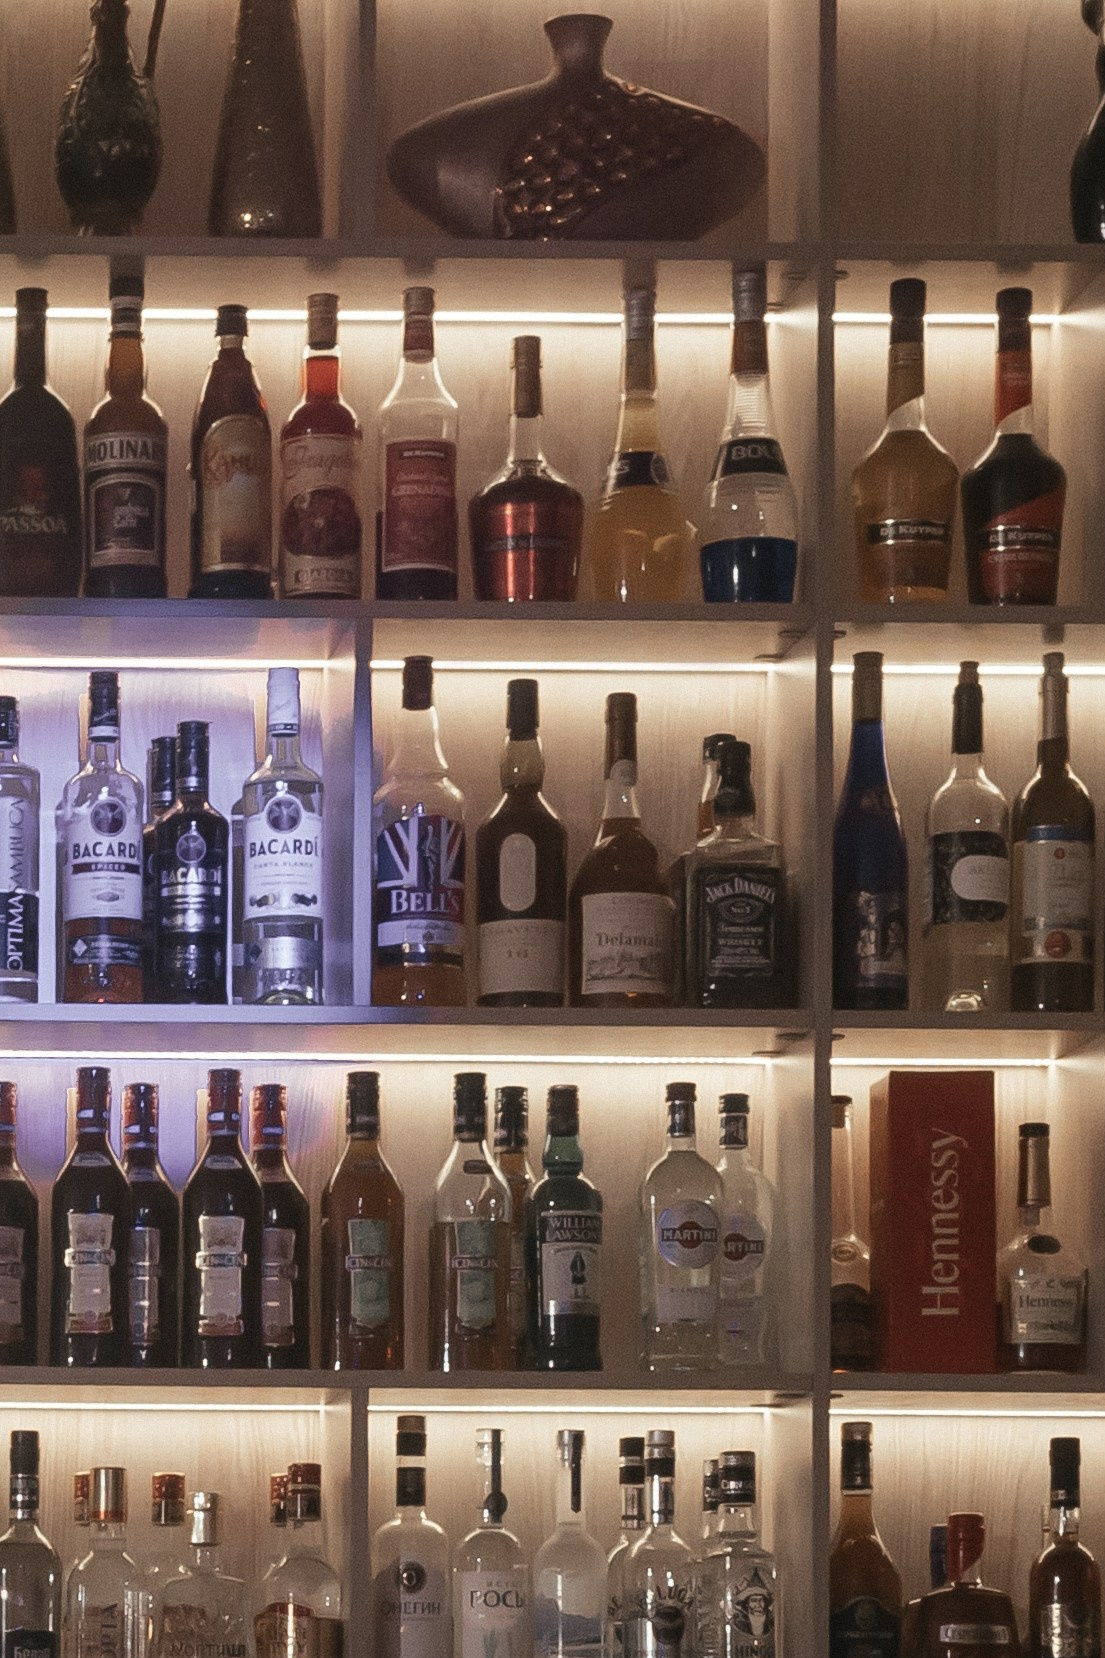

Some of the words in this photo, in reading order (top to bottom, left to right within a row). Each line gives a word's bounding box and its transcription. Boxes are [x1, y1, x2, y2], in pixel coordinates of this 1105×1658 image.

[391, 889, 461, 914] BELL'S
[705, 881, 734, 904] JACK
[6, 895, 25, 972] OPTIMA
[921, 1128, 970, 1317] Hennessy
[663, 1229, 717, 1242] MARTINI
